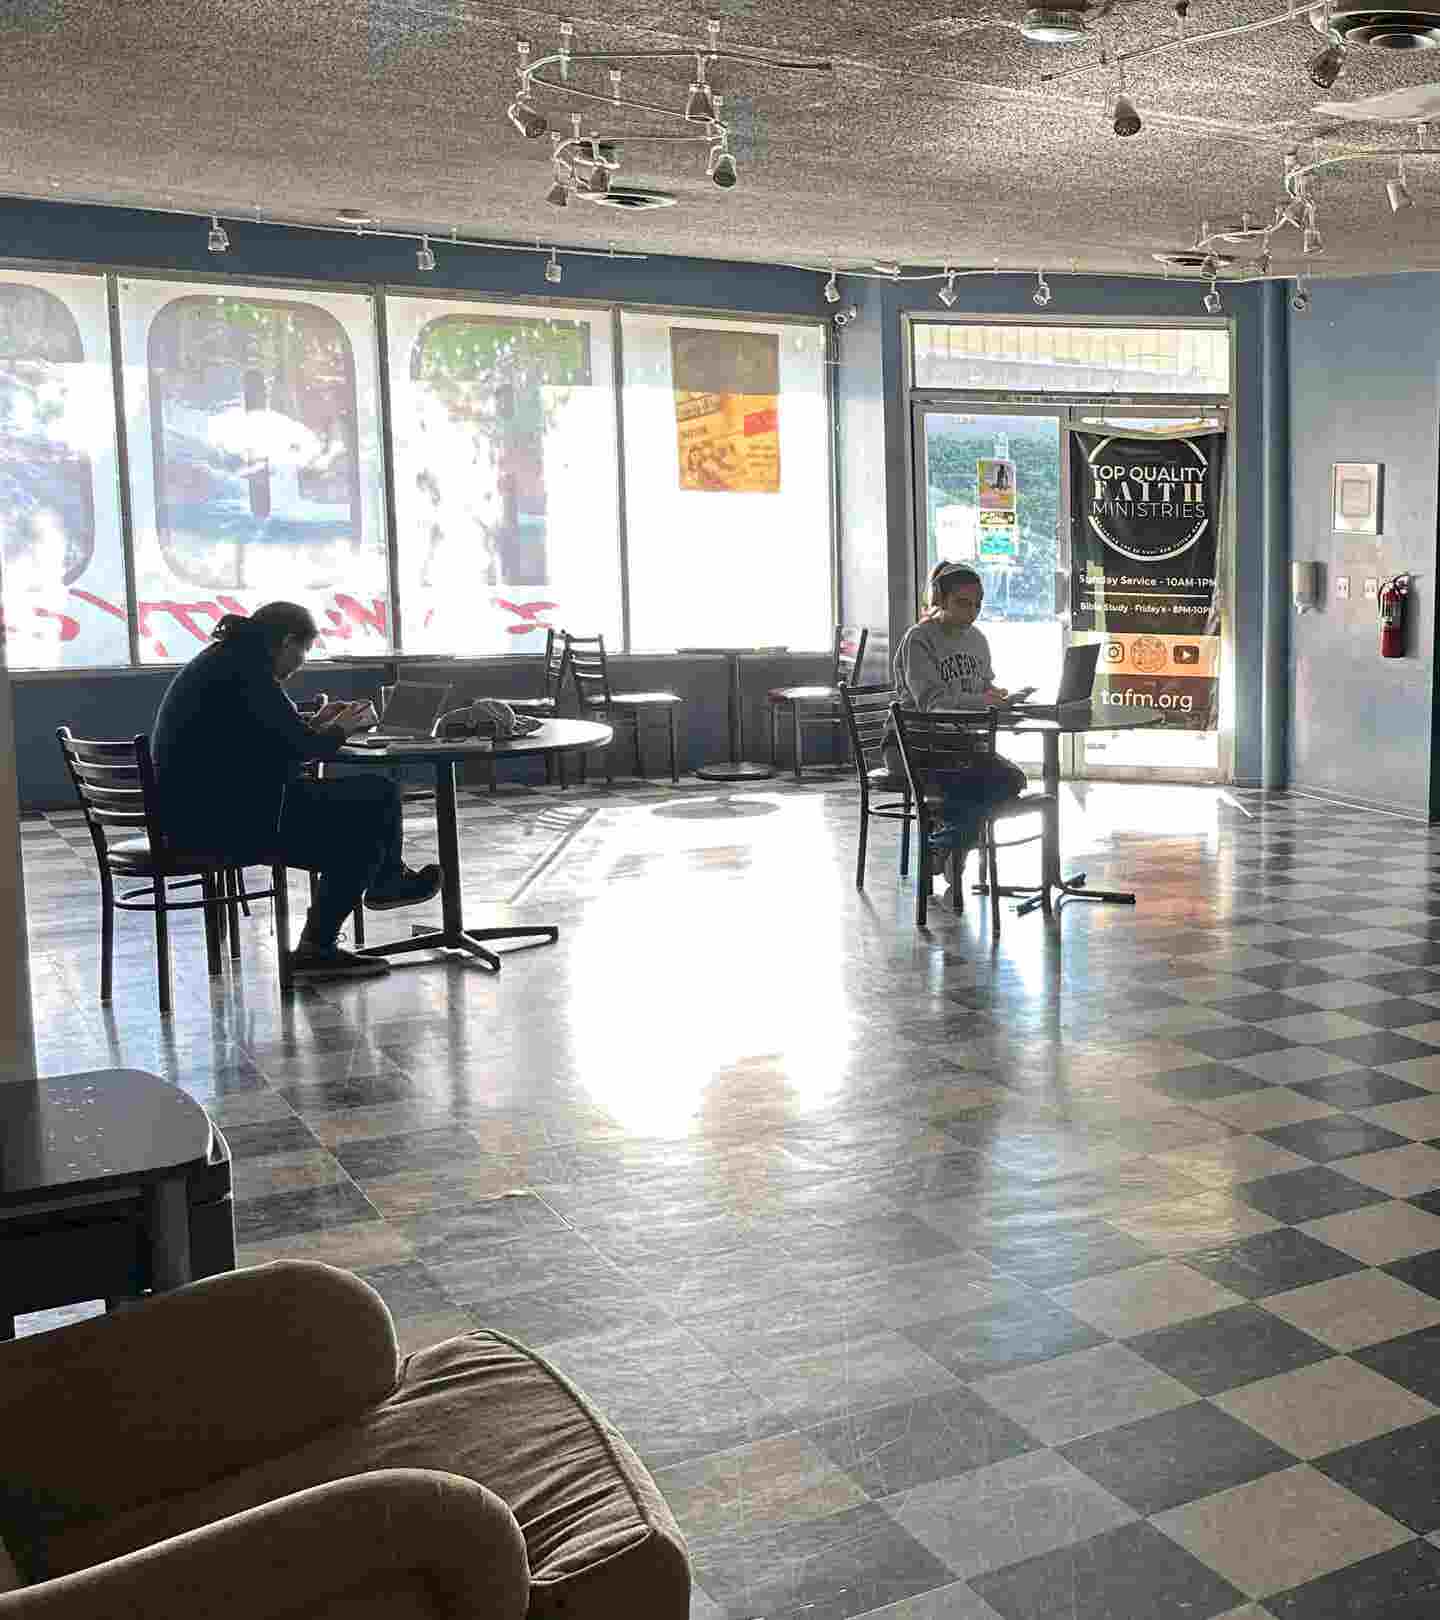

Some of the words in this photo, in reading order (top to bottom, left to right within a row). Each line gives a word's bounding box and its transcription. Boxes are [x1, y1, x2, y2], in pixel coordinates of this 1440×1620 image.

[1090, 465, 1125, 480] TOP
[1129, 466, 1207, 482] QUALITY
[1093, 480, 1203, 503] FAITH
[1092, 502, 1206, 519] MINISTRIES
[1120, 576, 1157, 588] Service
